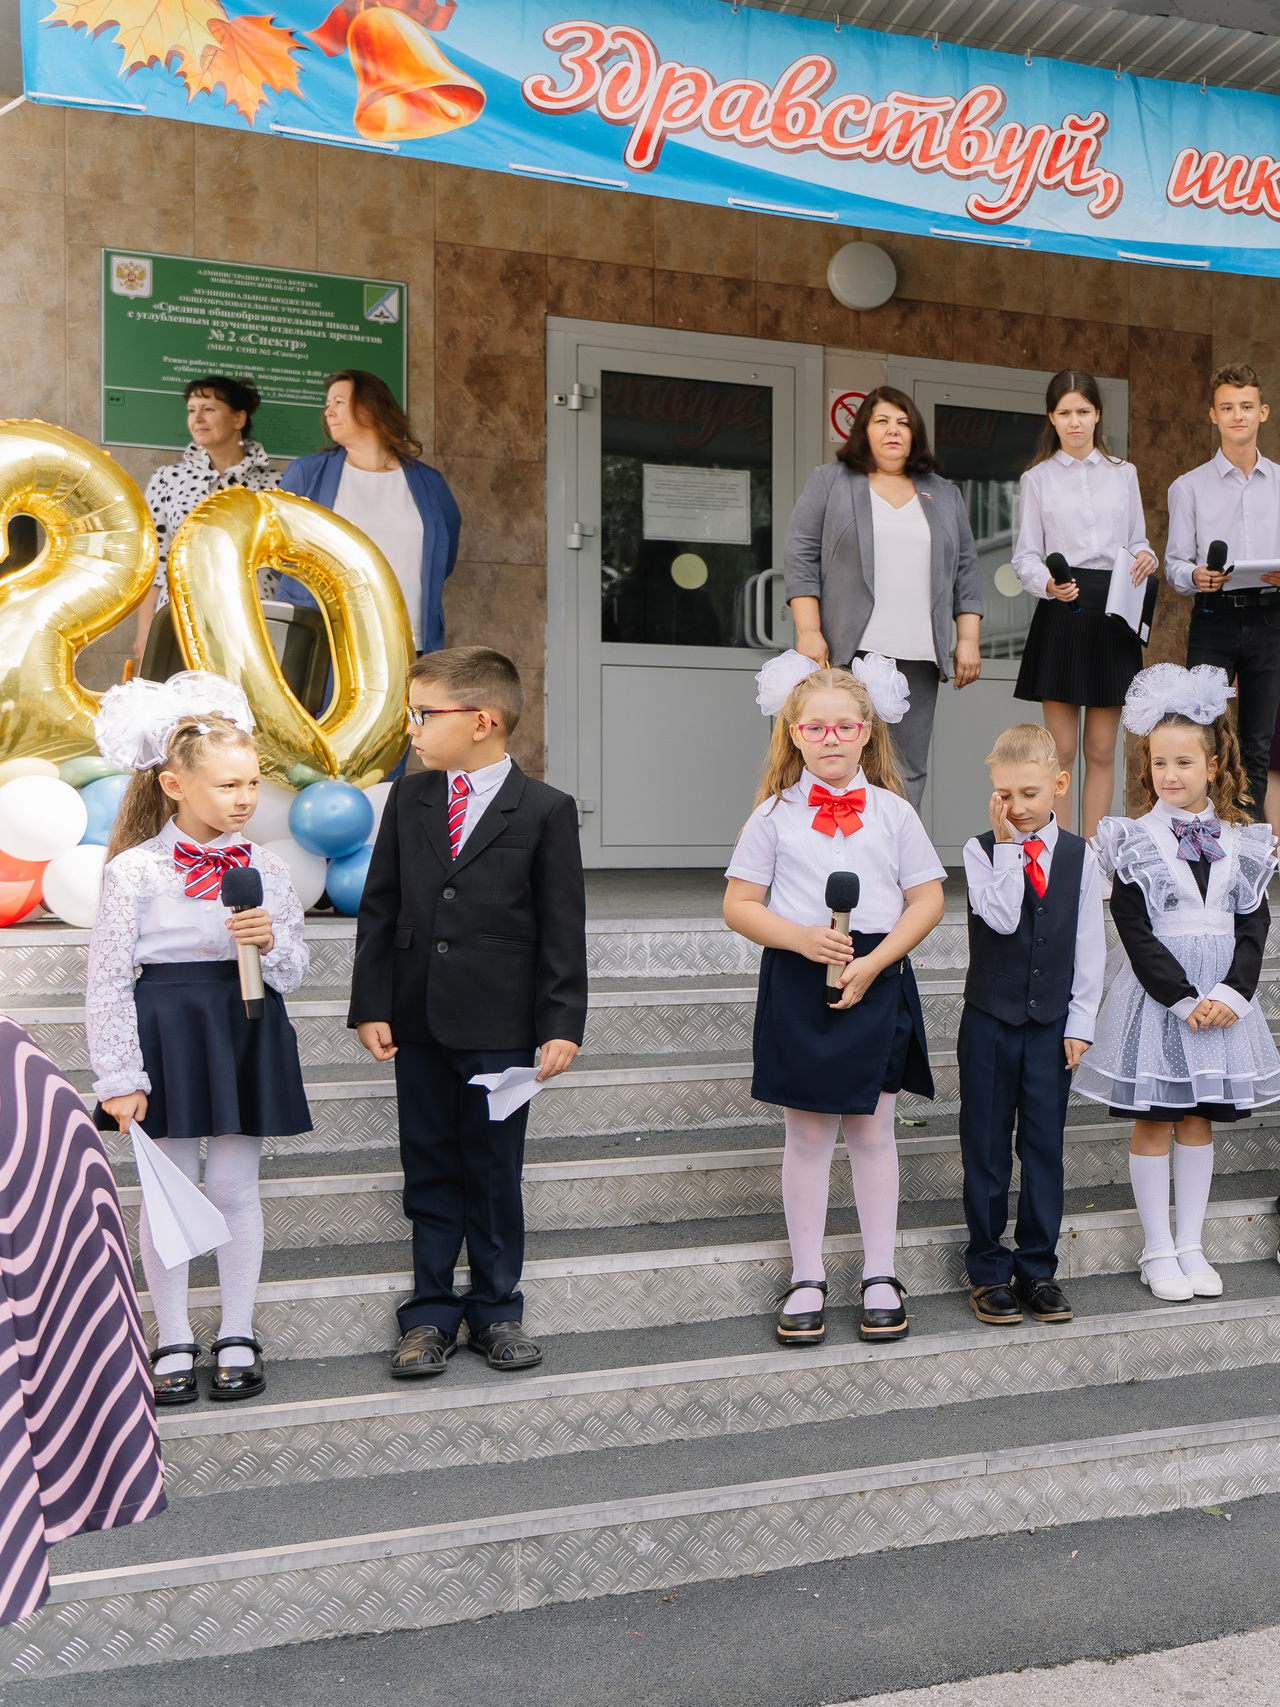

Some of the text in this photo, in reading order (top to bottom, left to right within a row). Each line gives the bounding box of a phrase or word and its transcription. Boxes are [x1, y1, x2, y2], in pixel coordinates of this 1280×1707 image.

[521, 17, 1123, 225] Здравствуй,
[197, 269, 319, 289] АДМИНИСТРАЦИЯ ГОРОДА БЕРДСКА
[210, 277, 306, 293] НОВОСИБИРСКОЙ ОБЛАСТИ
[178, 295, 336, 318] ОБЩЕОБРАЗОВАТЕЛЬНОЕ УЧРЕЖДЕНИЕ
[193, 288, 322, 308] МУНИЦИПАЛЬНОЕ БЮДЖЕТНОЕ
[136, 310, 210, 326] углубленным
[211, 320, 268, 331] изучением
[270, 326, 327, 338] отдельных
[329, 332, 383, 344] предметов
[152, 302, 360, 332] «Средняя общеобразовательная школа
[206, 343, 234, 352] (МБОУ
[236, 346, 257, 355] СОШ
[258, 347, 271, 355] №2
[208, 329, 308, 351] № 2 «Спектр»
[162, 356, 188, 364] Режим
[189, 359, 218, 368] работы:
[219, 362, 265, 372] понедельник
[173, 365, 203, 374] суббота
